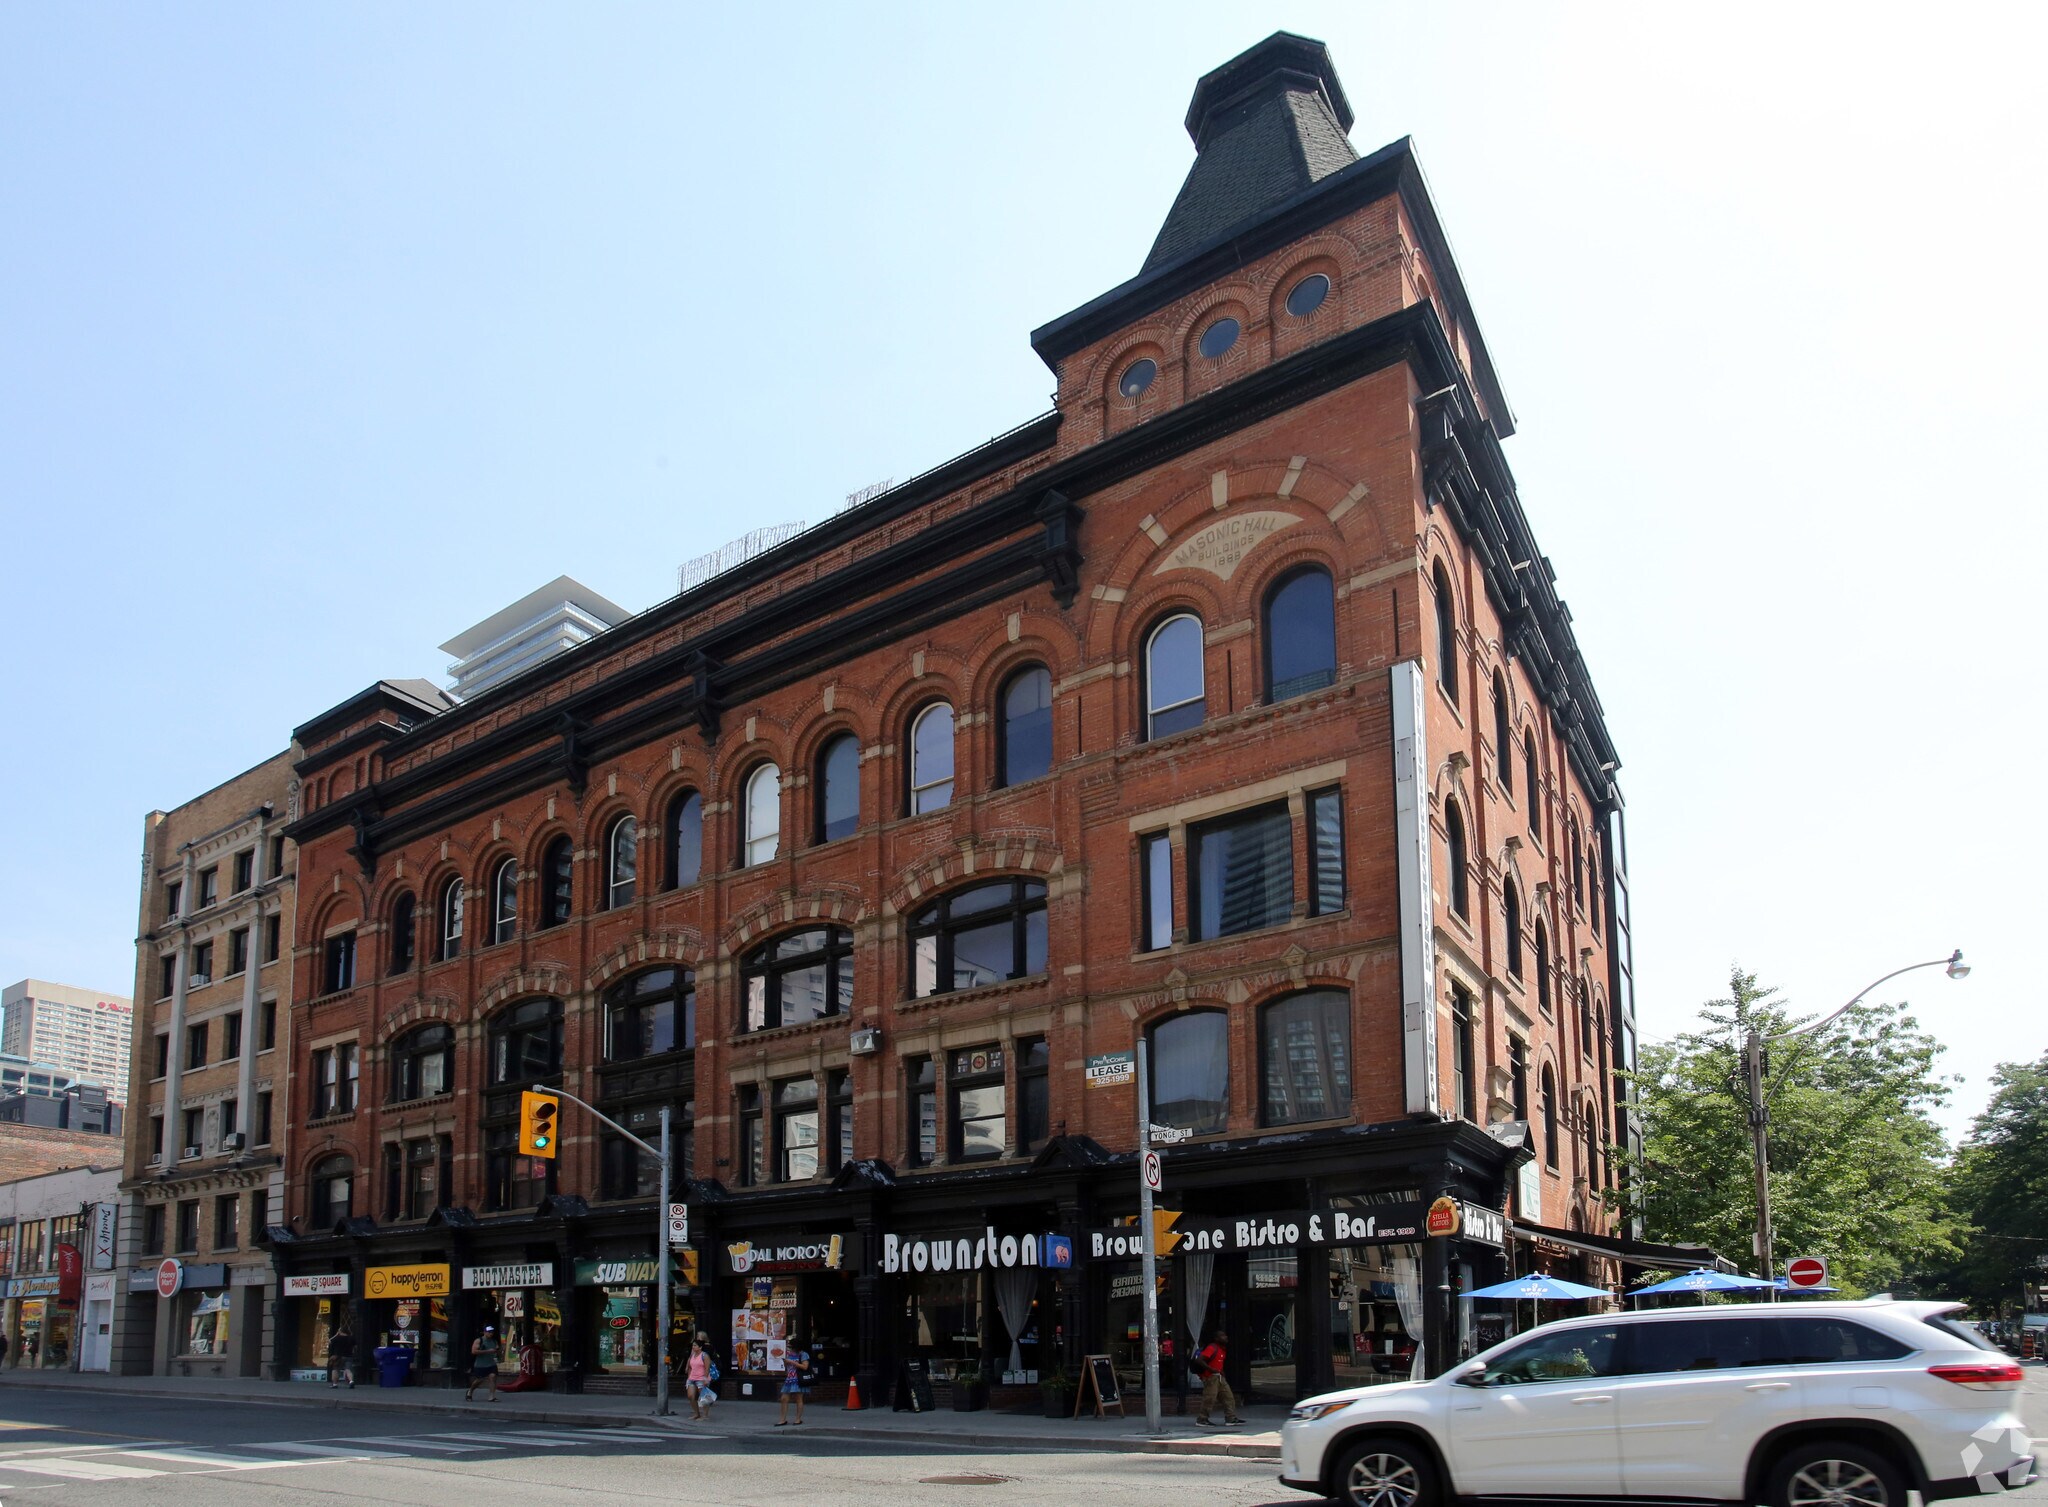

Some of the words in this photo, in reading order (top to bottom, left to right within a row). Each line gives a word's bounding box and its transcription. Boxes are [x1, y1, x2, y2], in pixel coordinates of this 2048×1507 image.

[1175, 520, 1240, 564] MASONIC
[1244, 517, 1276, 532] HALL
[1199, 534, 1255, 561] BUILDINGS
[1214, 551, 1241, 568] 1888
[1091, 1063, 1128, 1077] LEASE
[1154, 1131, 1176, 1140] YONGE
[1180, 1129, 1189, 1137] ST
[1432, 1211, 1450, 1219] STELLA
[1432, 1218, 1450, 1227] ARTOIS
[1464, 1206, 1484, 1239] Bistro
[1486, 1213, 1491, 1241] &
[1492, 1217, 1503, 1243] Bar
[1092, 1226, 1226, 1257] Browone
[1235, 1218, 1300, 1248] Bistro
[1308, 1214, 1325, 1242] &
[1334, 1212, 1376, 1240] Bar
[1377, 1228, 1396, 1238] EST.
[1396, 1226, 1416, 1236] 1999
[750, 1248, 775, 1262] DAL
[777, 1243, 830, 1261] MORO'S
[884, 1226, 1038, 1273] Brownston
[161, 1271, 176, 1279] Money
[292, 1279, 310, 1288] PHONE
[319, 1276, 342, 1288] SQUARE
[391, 1271, 444, 1292] happylemon
[472, 1264, 543, 1287] BOOTMASTER
[593, 1261, 660, 1284] SUBWAY
